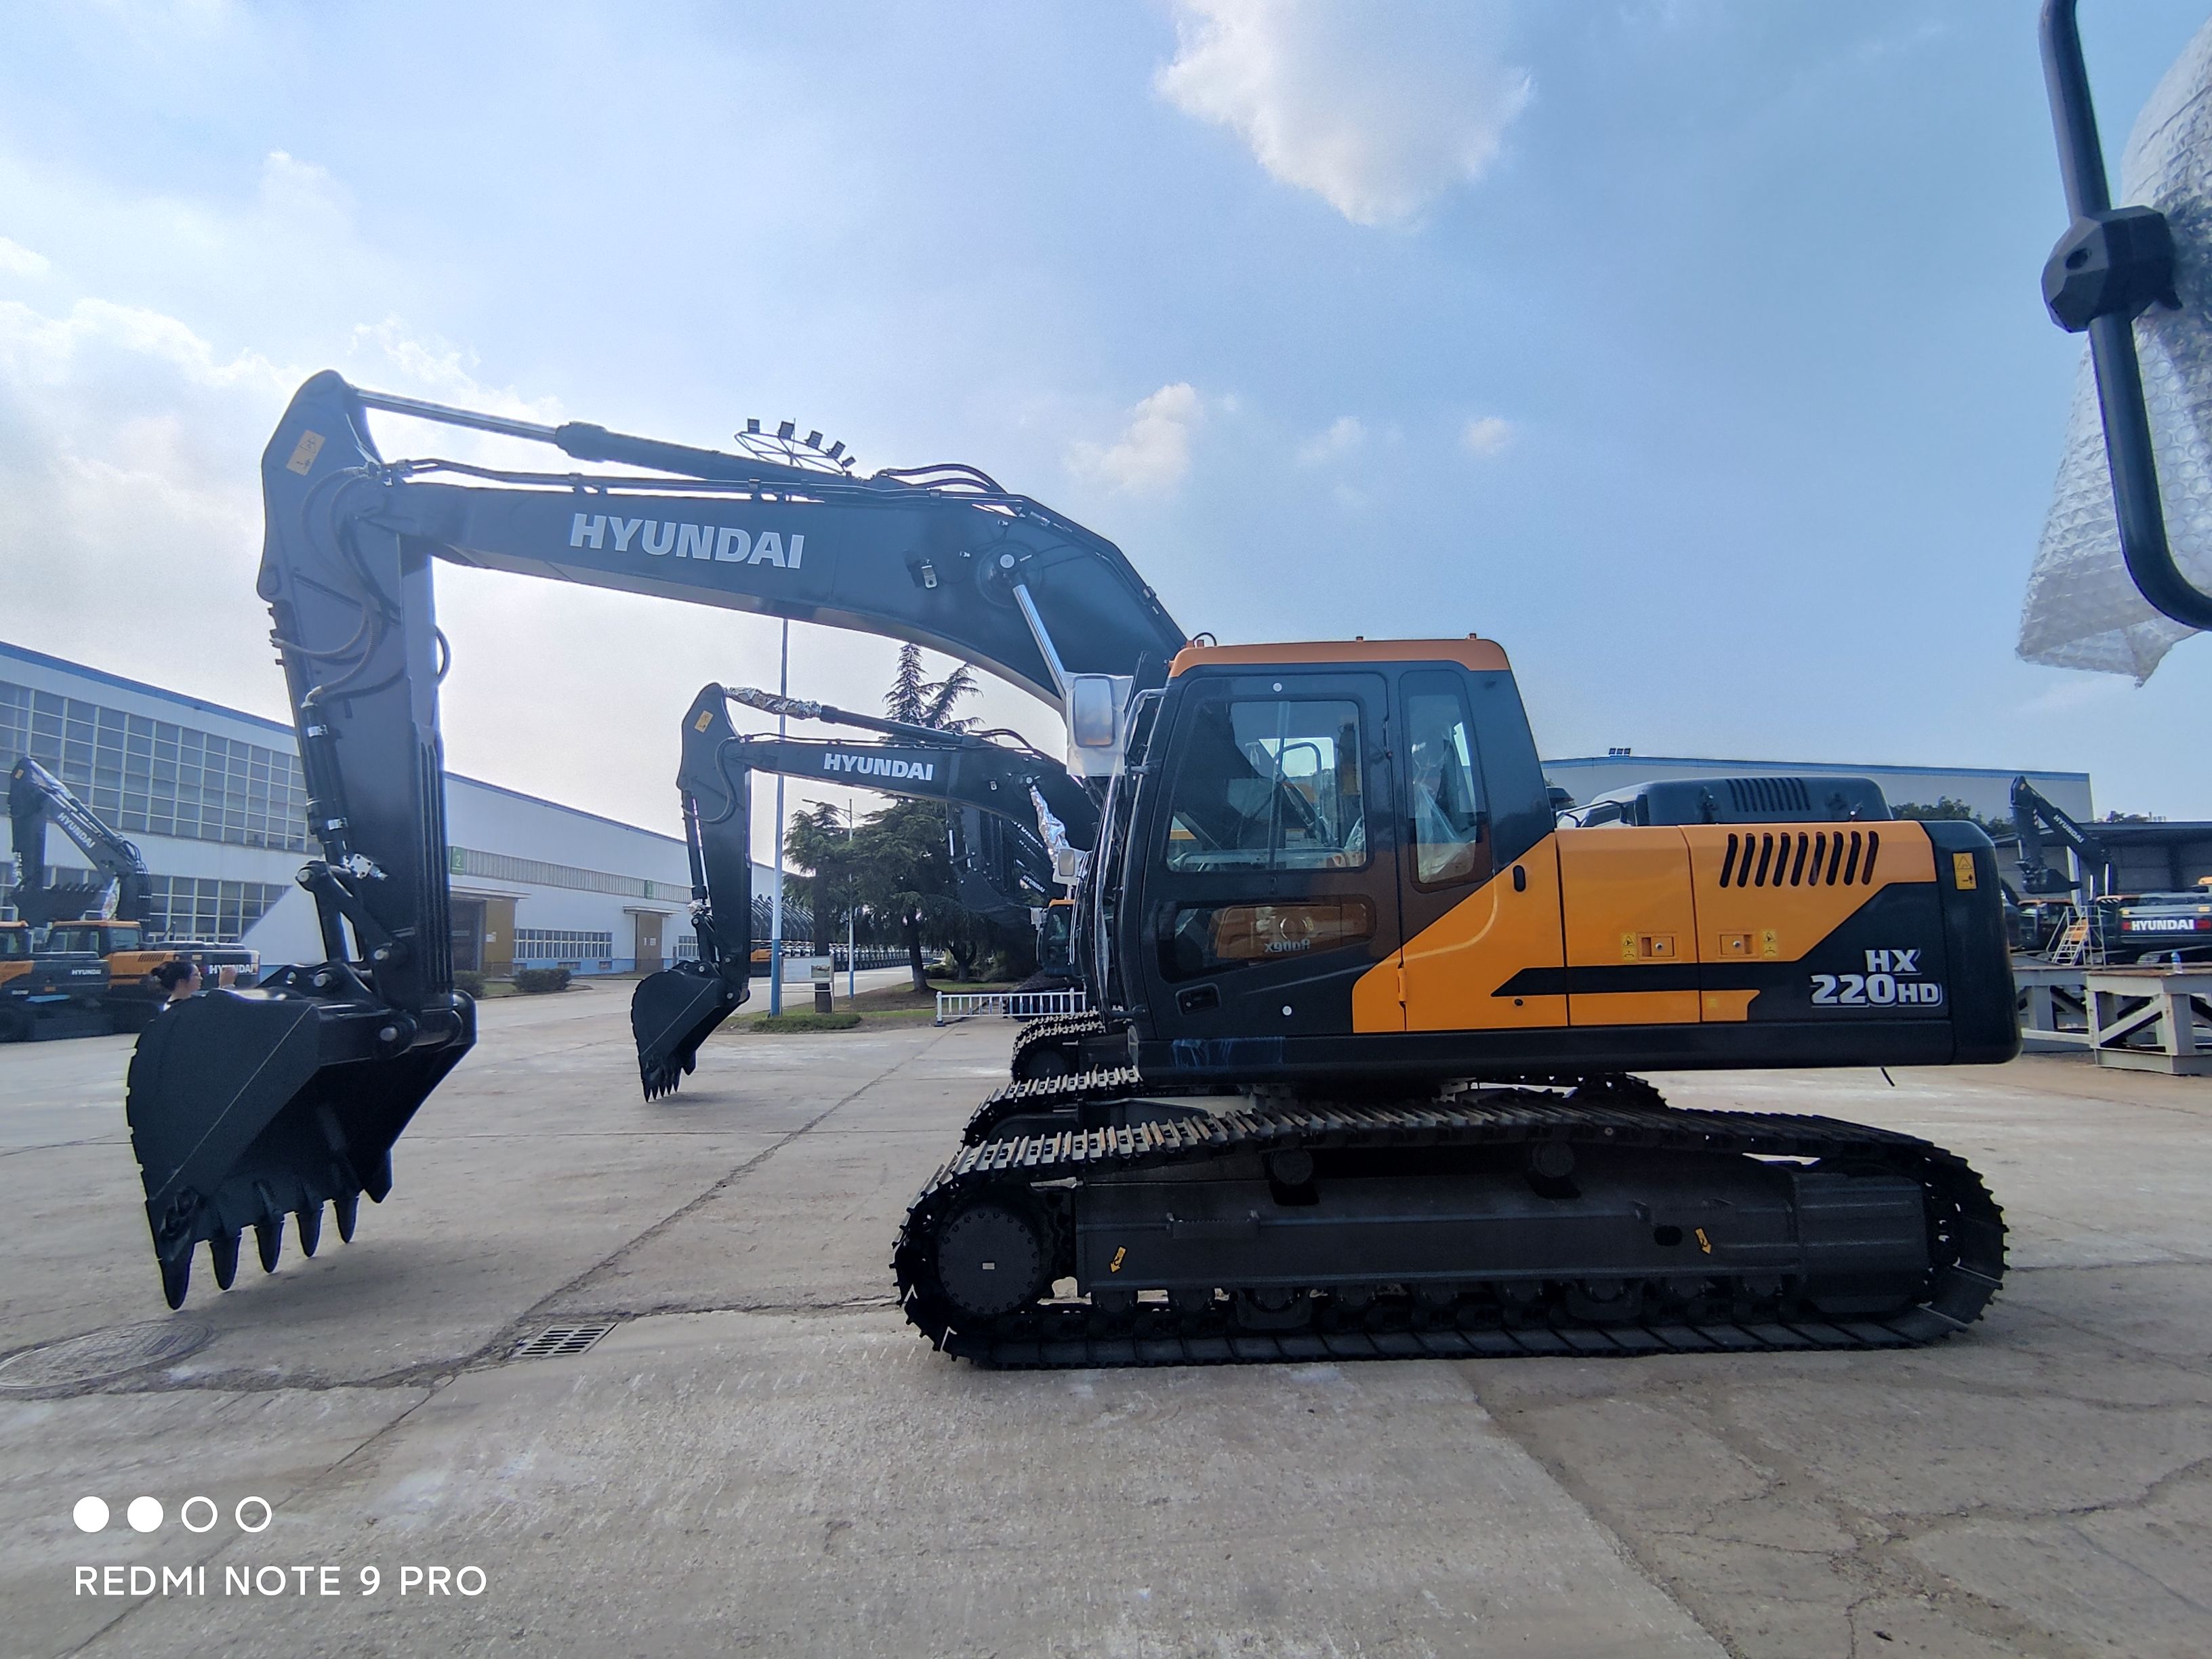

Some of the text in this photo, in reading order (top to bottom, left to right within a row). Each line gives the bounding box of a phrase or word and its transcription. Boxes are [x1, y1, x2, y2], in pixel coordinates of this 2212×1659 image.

[570, 513, 804, 569] HYUNDAI
[824, 753, 933, 781] HYUNDAI
[58, 813, 96, 848] HYUNDAI
[2053, 815, 2085, 844] HYUNDAI
[456, 855, 461, 867] 2
[1022, 874, 1046, 893] HYUNDAI
[2131, 919, 2194, 931] HYUNDAI
[209, 964, 253, 975] HYNDAI
[1865, 949, 1918, 972] HX
[1810, 974, 1941, 1004] 220HD
